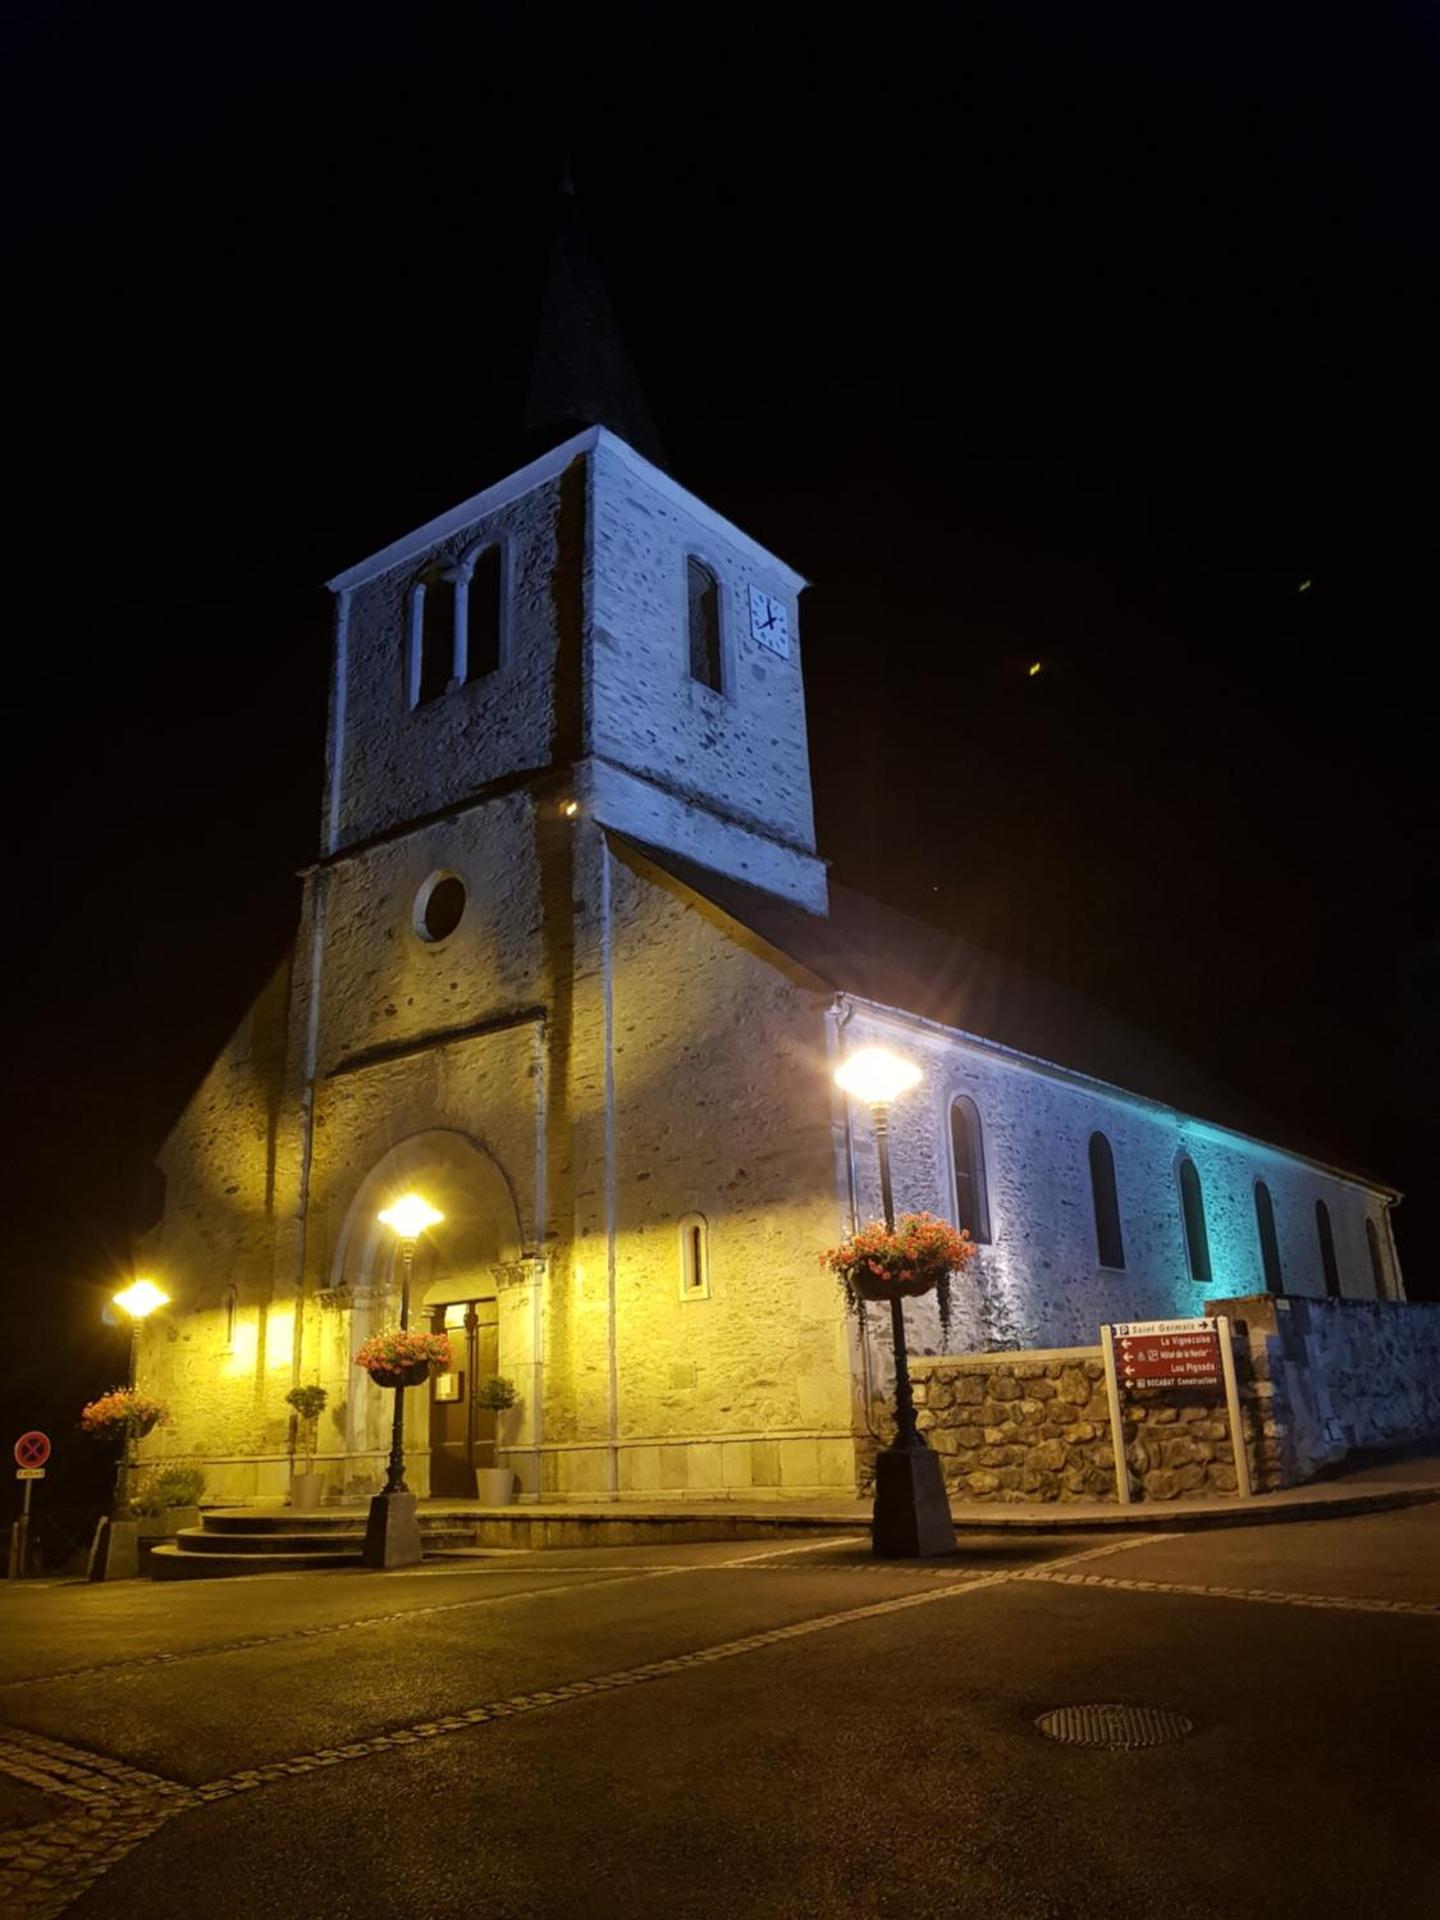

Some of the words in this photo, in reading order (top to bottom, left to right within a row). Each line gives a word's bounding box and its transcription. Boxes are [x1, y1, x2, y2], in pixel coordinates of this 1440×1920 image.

[1132, 1325, 1155, 1334] Saint
[1159, 1322, 1195, 1333] Germain
[1160, 1337, 1170, 1346] La
[1171, 1363, 1185, 1373] Lou
